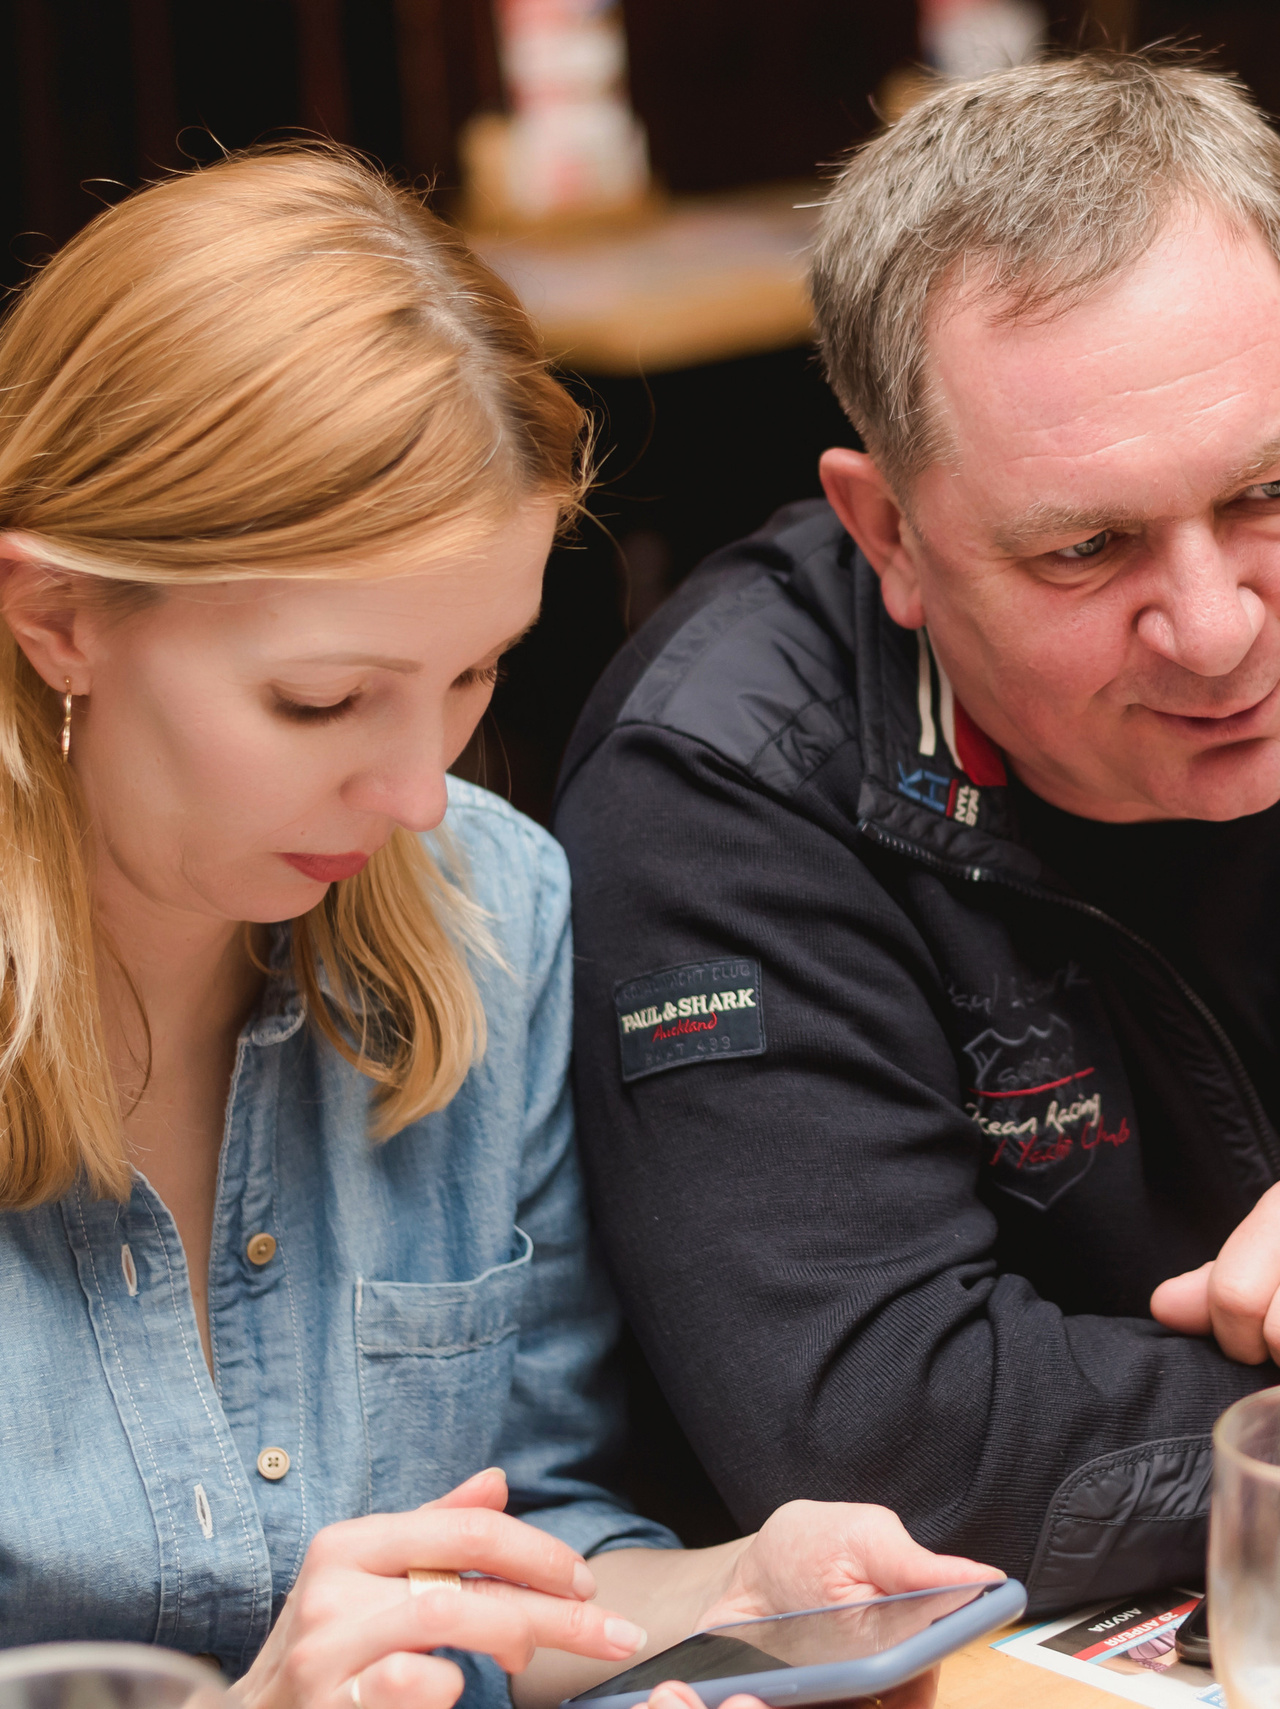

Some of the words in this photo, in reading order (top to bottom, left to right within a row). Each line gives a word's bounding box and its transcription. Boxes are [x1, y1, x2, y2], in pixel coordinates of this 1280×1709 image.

[711, 964, 751, 982] CLUB
[652, 1012, 718, 1043] Auckland
[1045, 1092, 1101, 1135] Racing
[1087, 1607, 1143, 1633] АКУЛА
[1156, 1611, 1180, 1624] 29
[1103, 1618, 1161, 1648] АПРЕЛЯ
